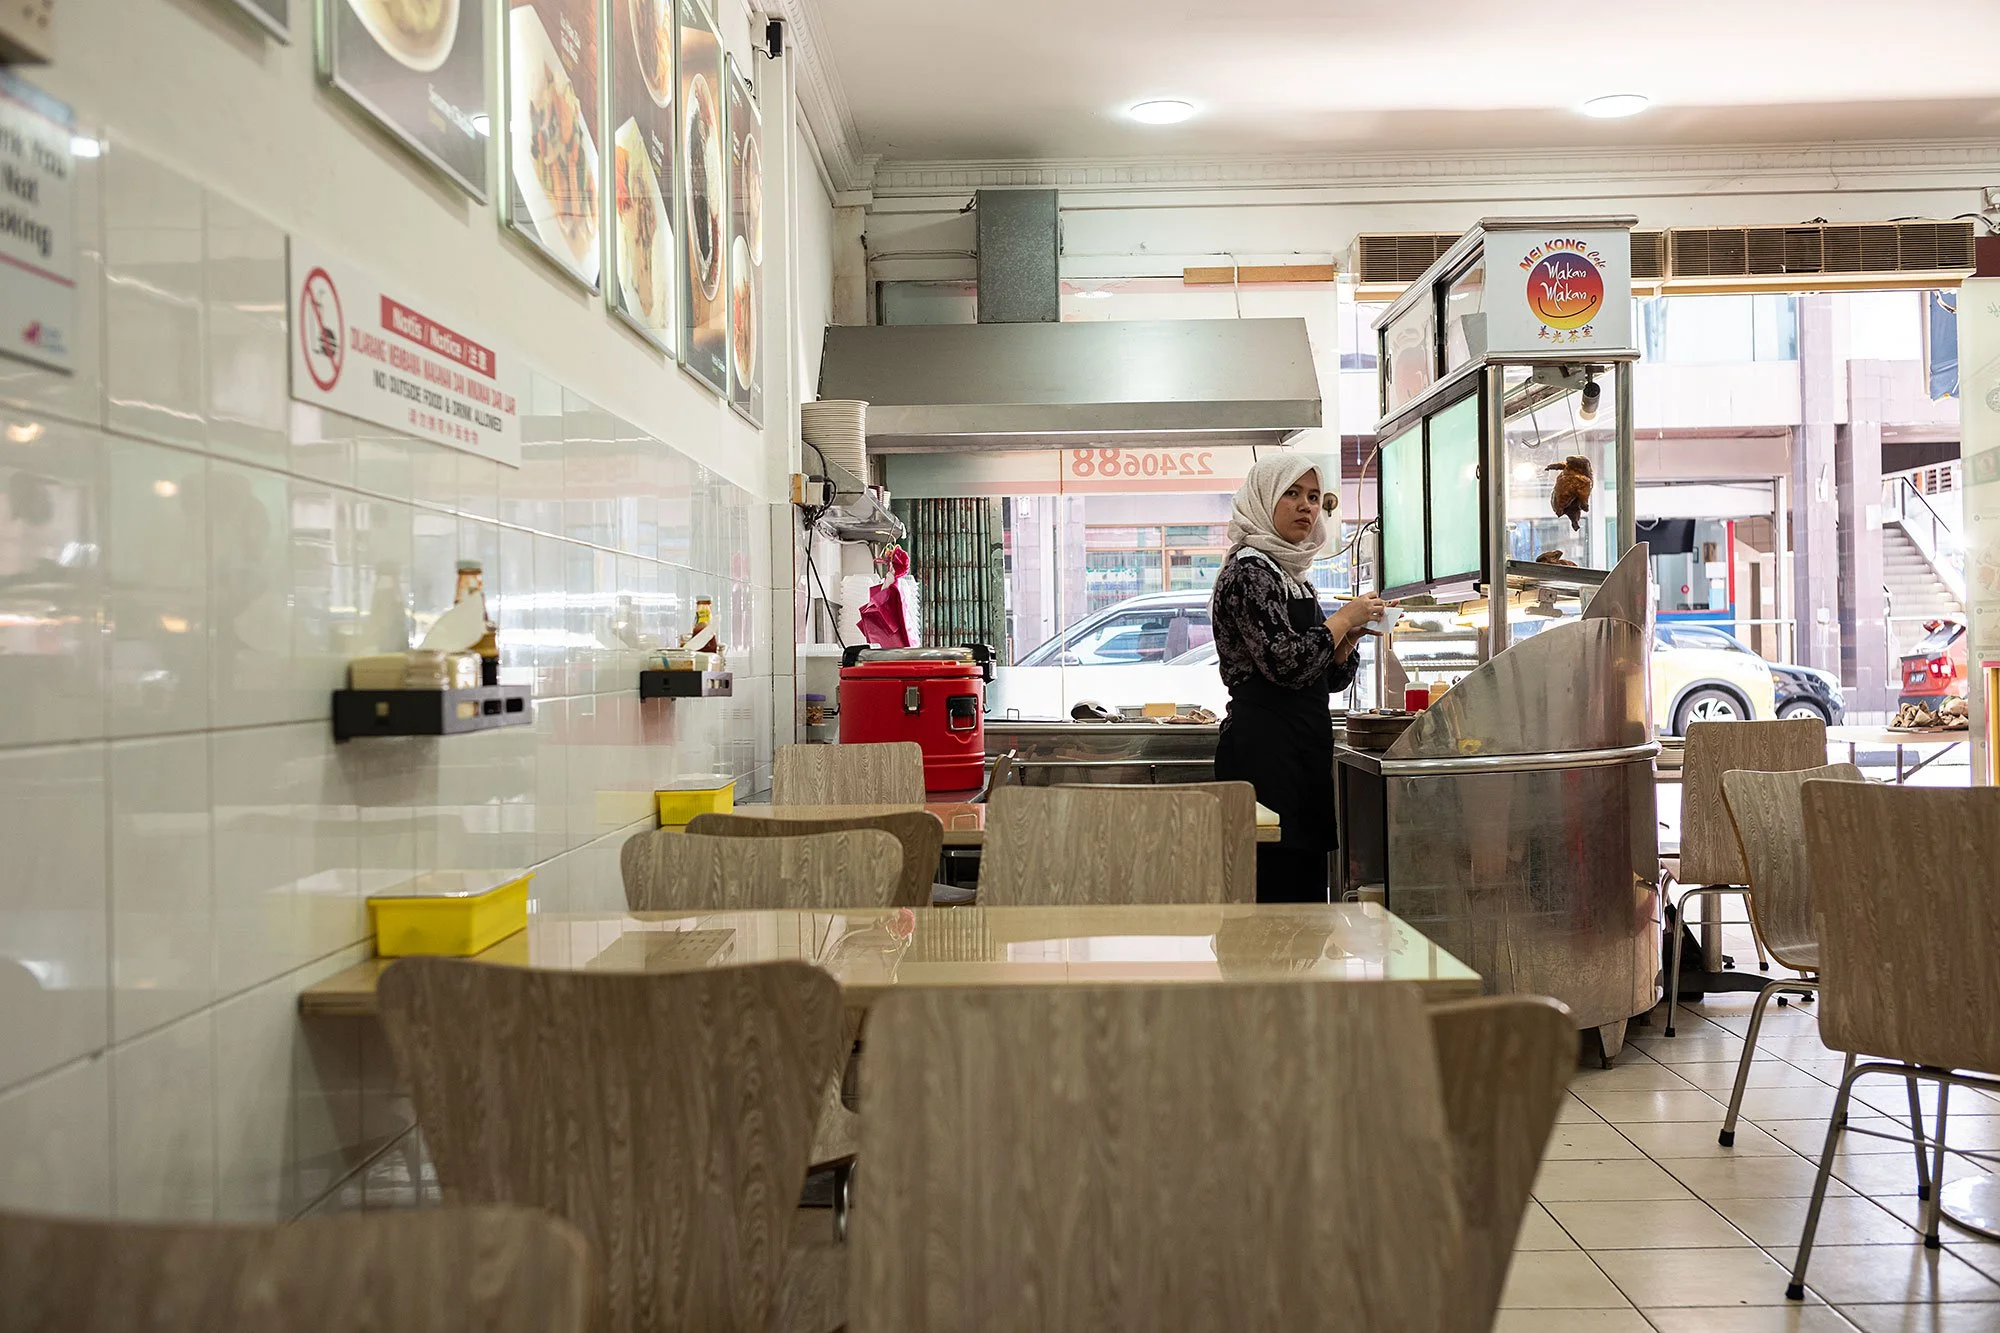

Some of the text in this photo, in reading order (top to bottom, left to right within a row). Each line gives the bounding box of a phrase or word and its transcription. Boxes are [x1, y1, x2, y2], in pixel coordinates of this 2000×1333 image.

[1519, 247, 1543, 271] MEI
[1544, 239, 1587, 253] KONG
[1543, 261, 1587, 288] Makan
[1540, 282, 1587, 312] Makan
[392, 307, 423, 341] Notis
[430, 325, 463, 358] Notice
[1538, 324, 1594, 344] 美光茶室
[373, 369, 386, 391] NO
[389, 375, 421, 403] OUTSIDE
[423, 388, 442, 410] FOOD
[474, 408, 502, 433] ALLOWED
